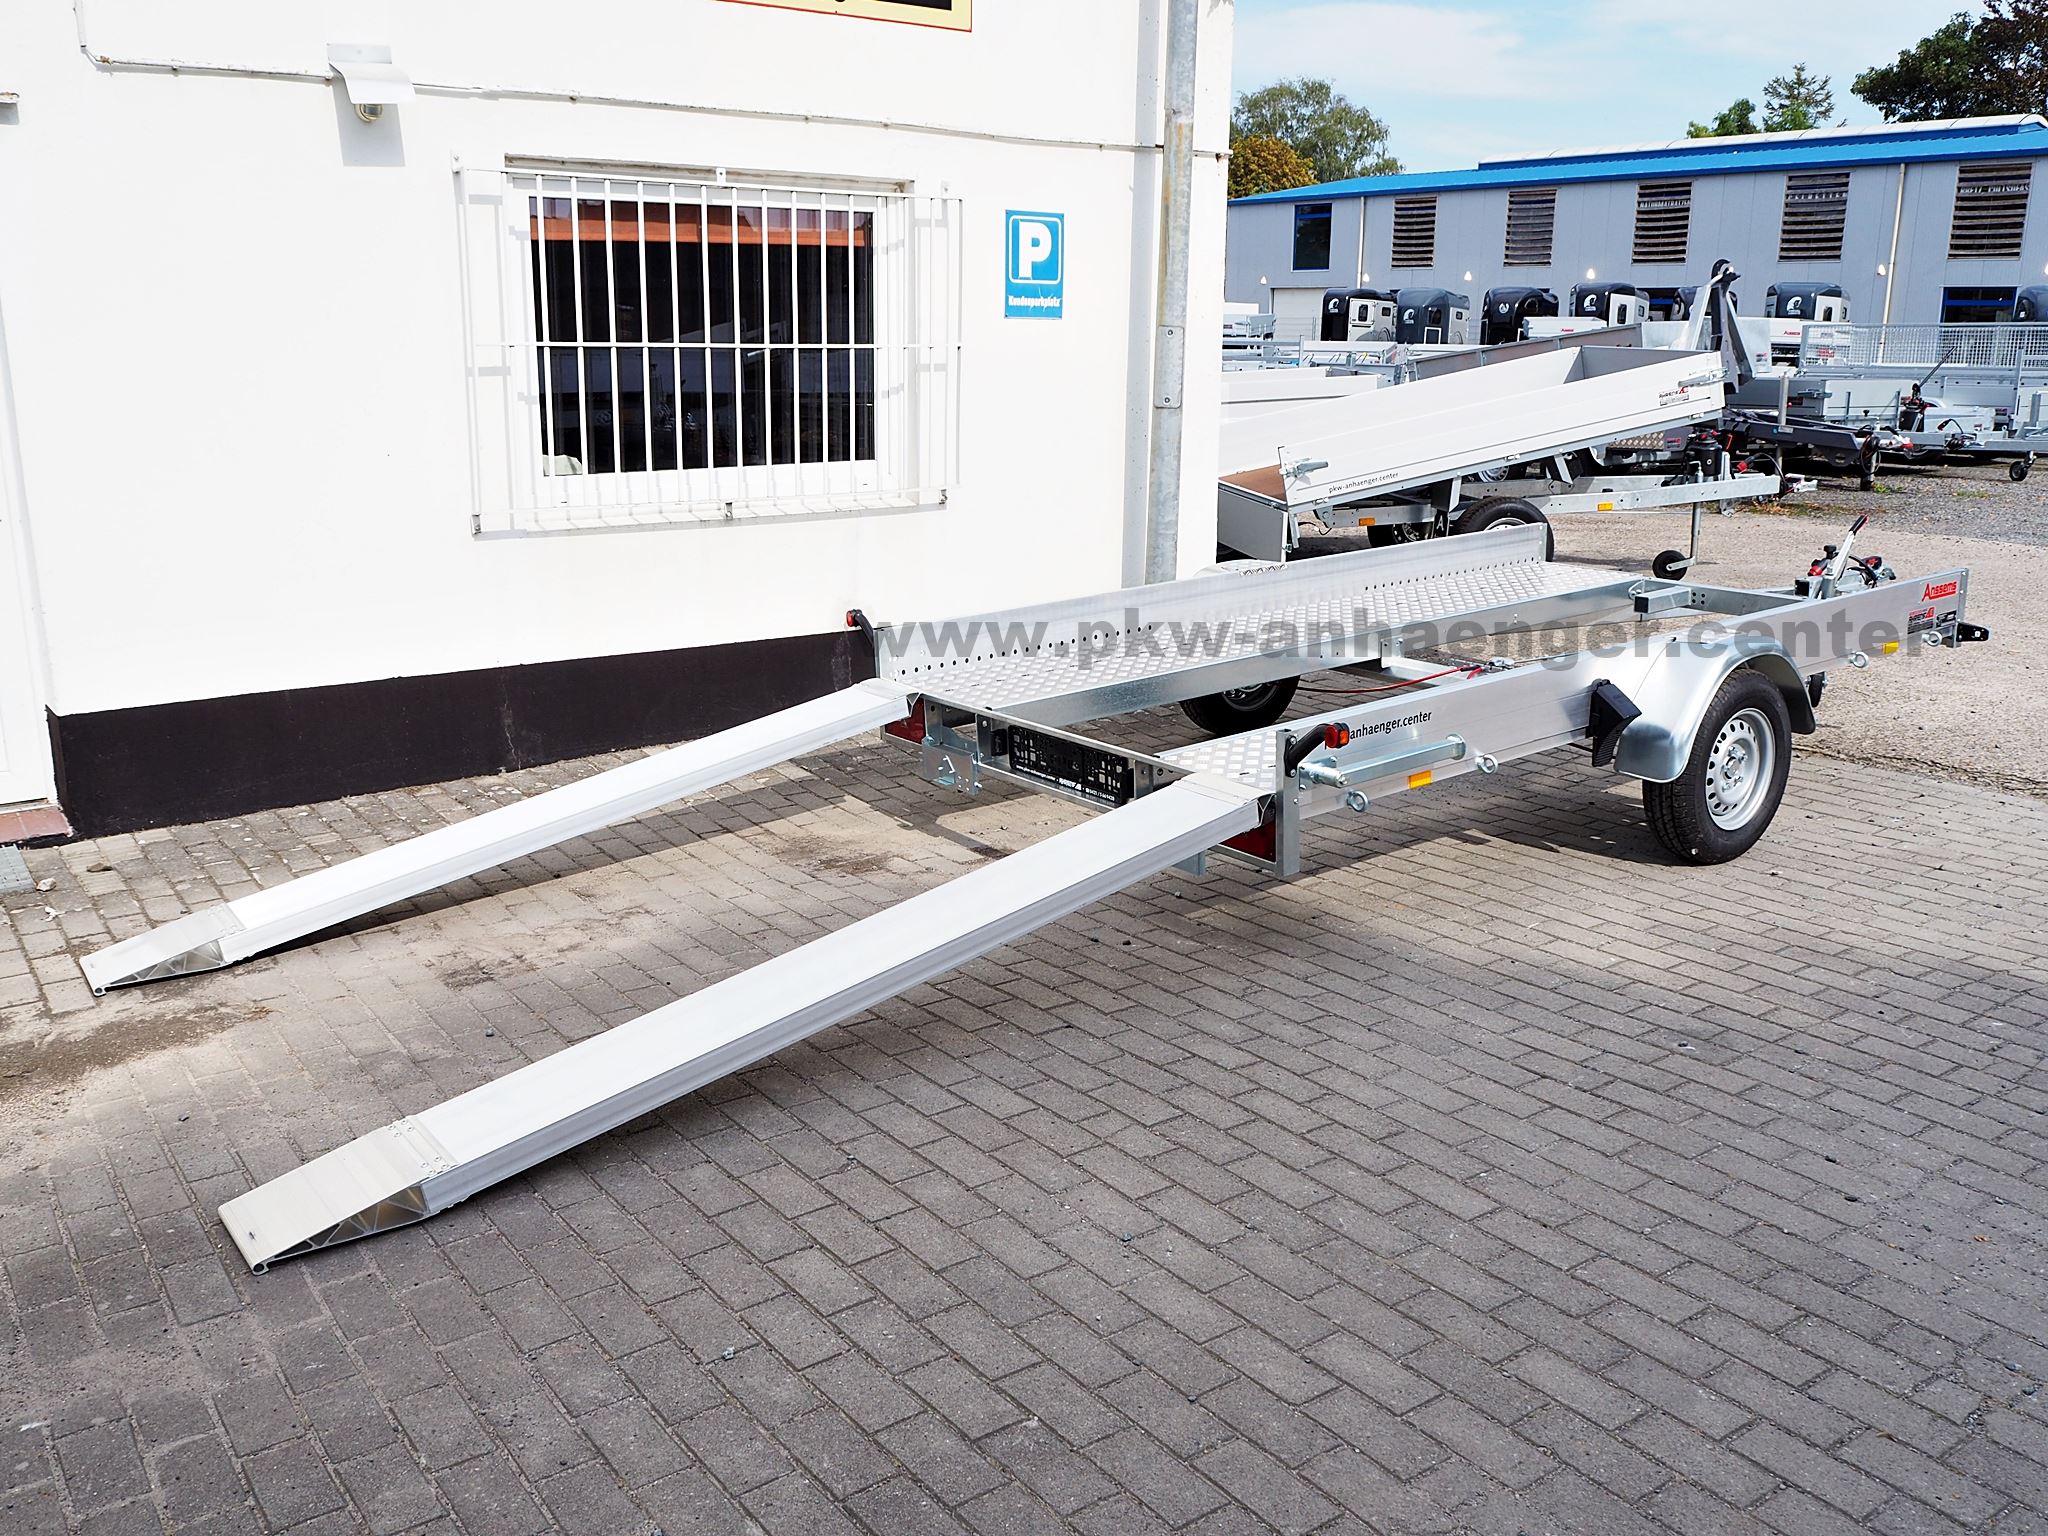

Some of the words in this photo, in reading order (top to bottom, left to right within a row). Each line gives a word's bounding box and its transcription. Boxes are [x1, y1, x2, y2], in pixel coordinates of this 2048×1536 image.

[1018, 221, 1052, 279] P
[1328, 472, 1399, 494] pkw-anhaenger.center
[1921, 580, 1958, 602] Anssems
